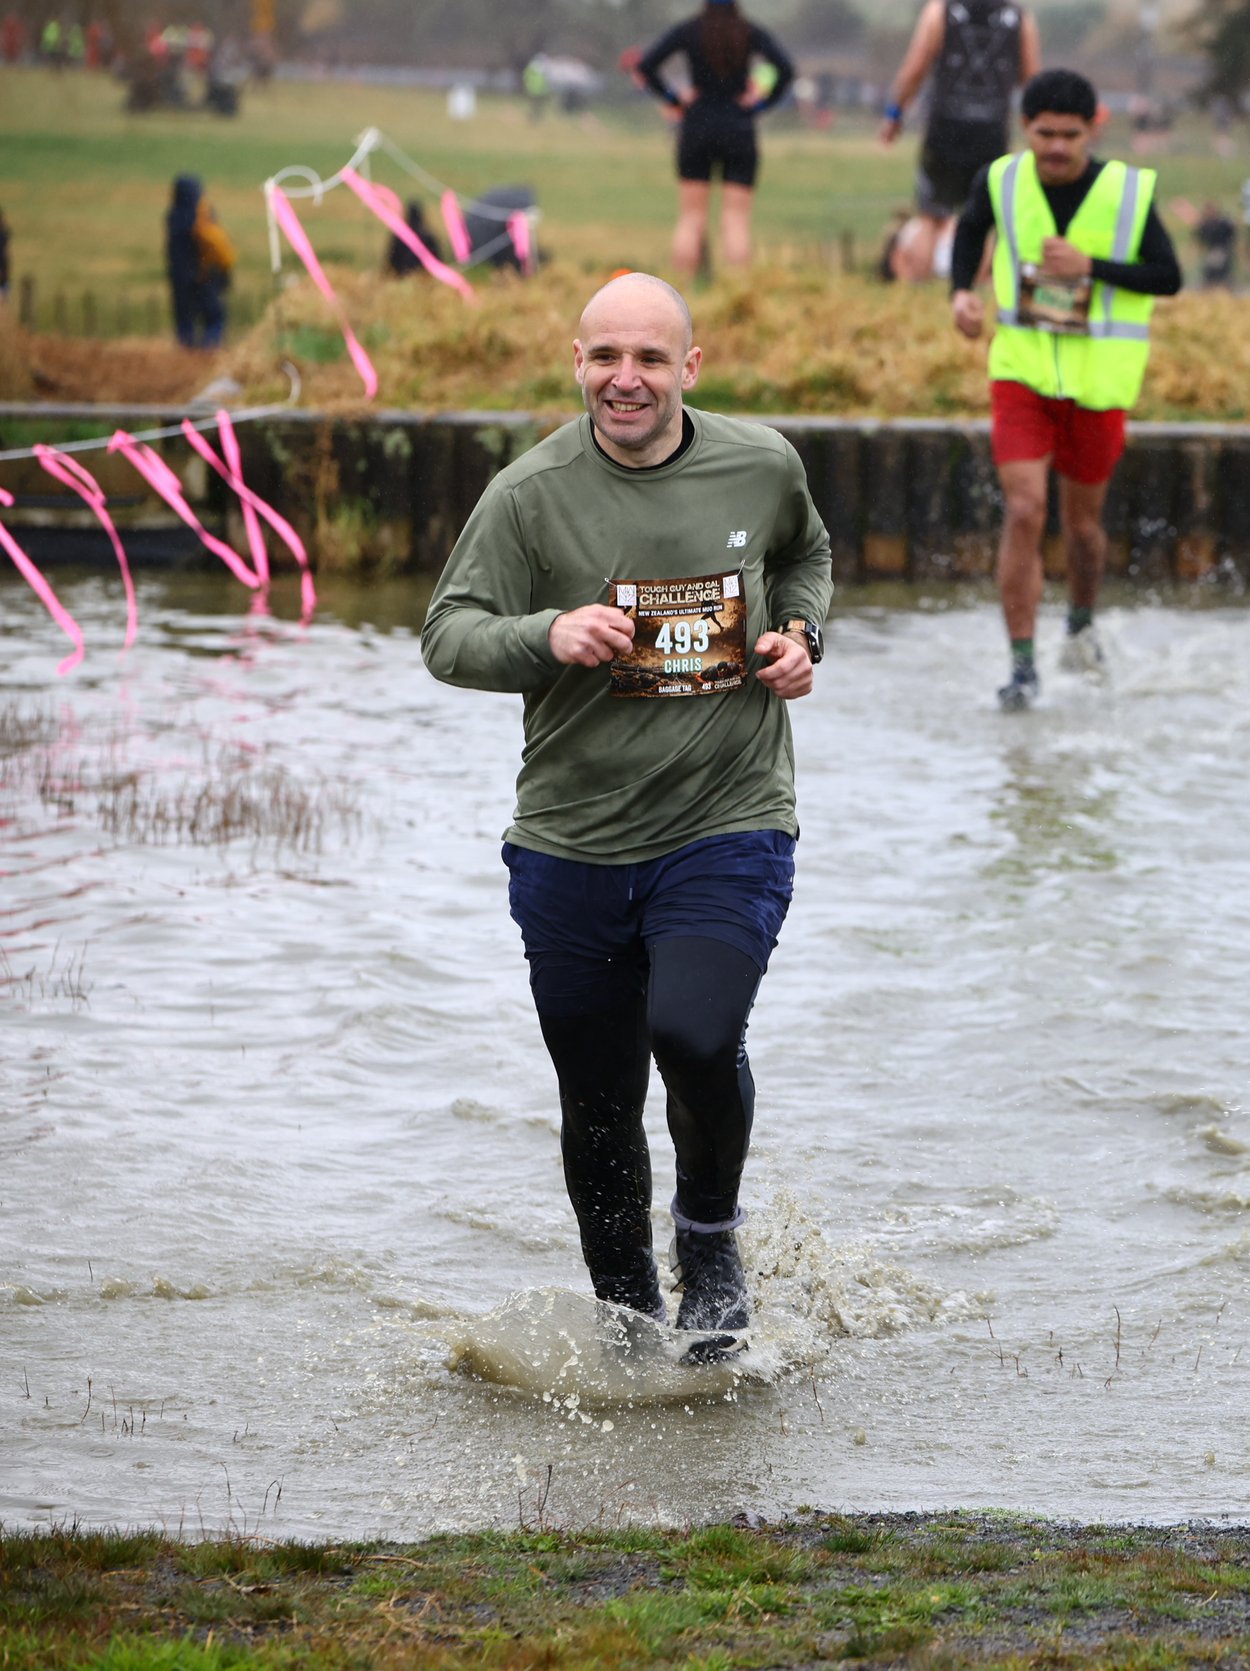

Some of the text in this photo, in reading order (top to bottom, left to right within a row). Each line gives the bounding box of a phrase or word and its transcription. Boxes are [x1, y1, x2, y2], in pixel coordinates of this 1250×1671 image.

[639, 580, 720, 594] TOUGH GUY AND GAL
[639, 588, 721, 606] CHALLENGE
[678, 607, 702, 615] ULTIMATE
[655, 619, 709, 655] 493
[664, 657, 703, 674] CHRIS
